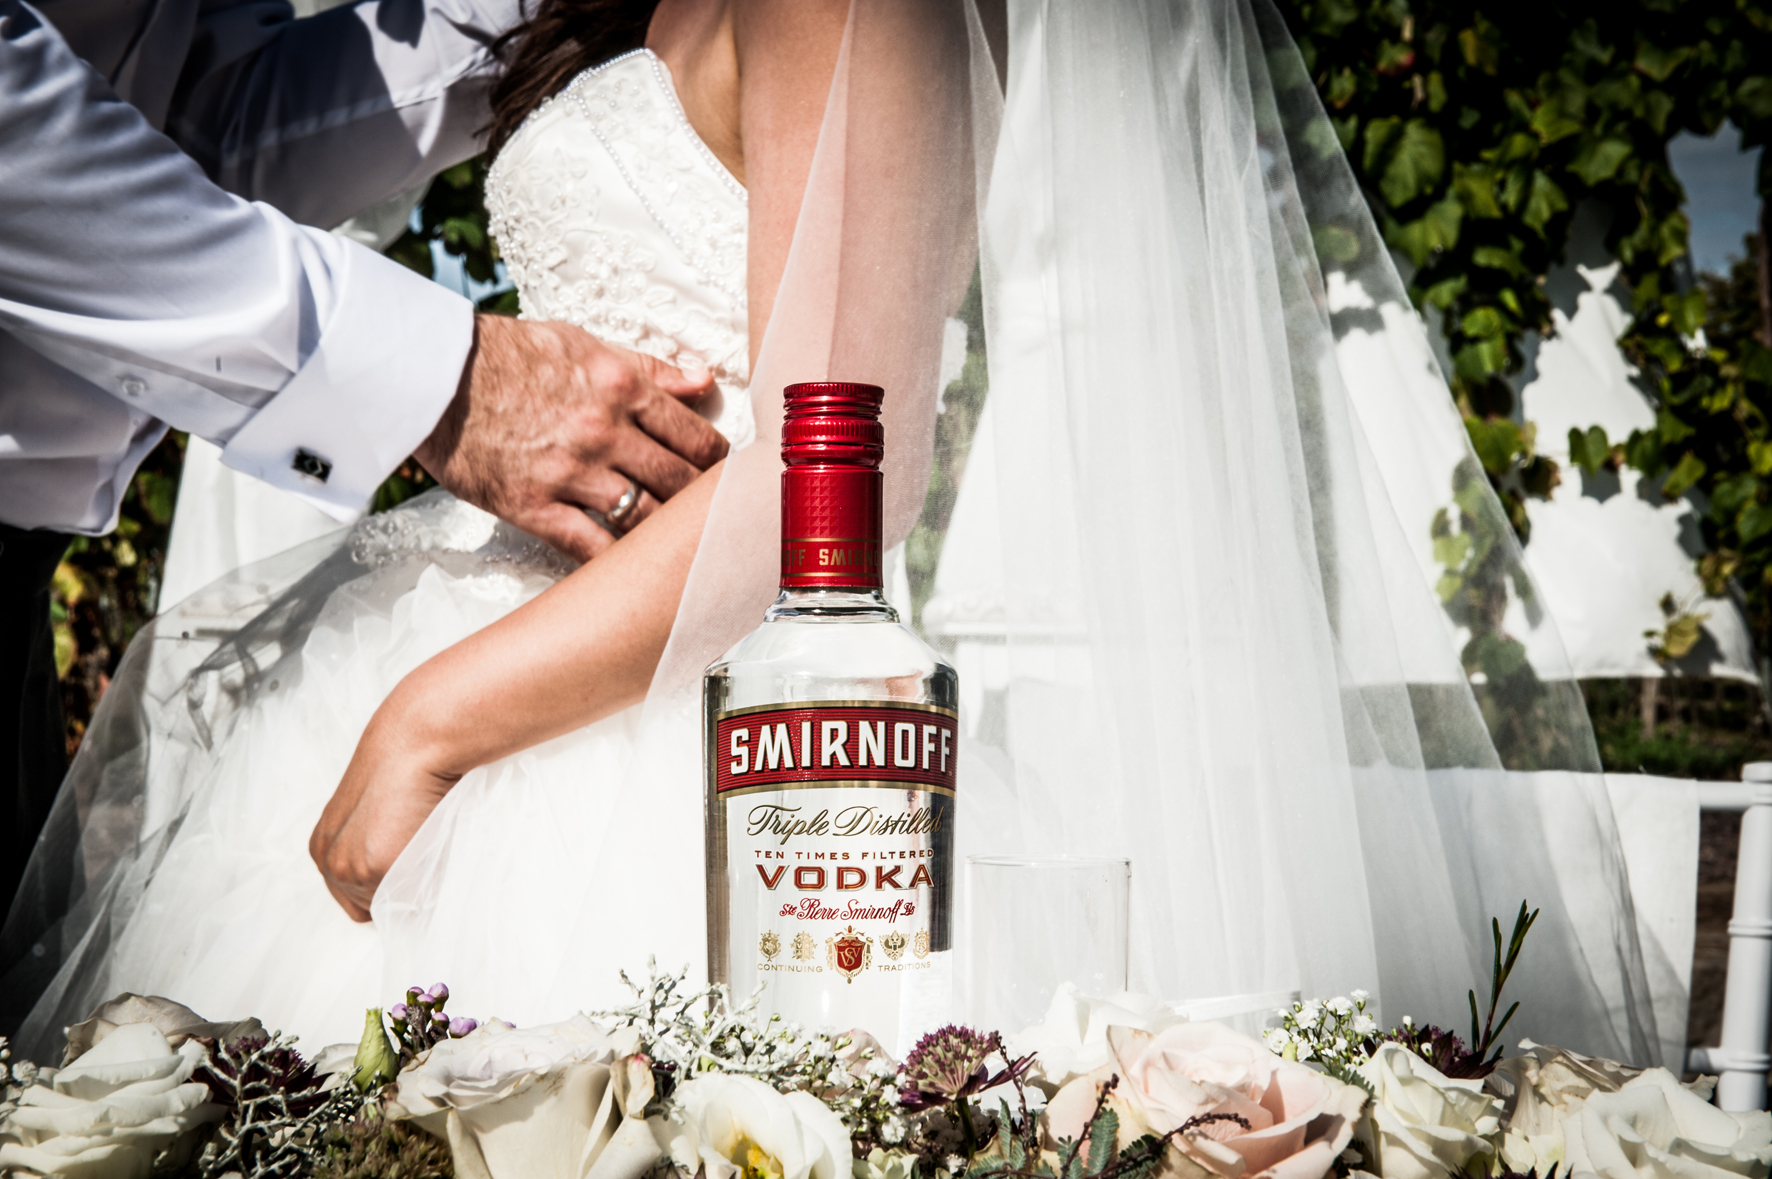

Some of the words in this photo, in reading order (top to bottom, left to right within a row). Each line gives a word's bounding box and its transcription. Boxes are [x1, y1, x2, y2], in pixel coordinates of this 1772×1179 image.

[730, 720, 952, 776] SMIRNOFF
[747, 804, 830, 845] Triple
[832, 805, 944, 837] Distilled
[755, 850, 784, 859] TEN
[795, 851, 850, 860] TIMES
[861, 849, 934, 860] FILTERED
[755, 863, 934, 891] VODKA
[797, 897, 840, 920] Pierre
[840, 898, 904, 923] Smirnoff
[757, 963, 823, 973] CONTINUING
[878, 961, 931, 972] TRADITIONS
